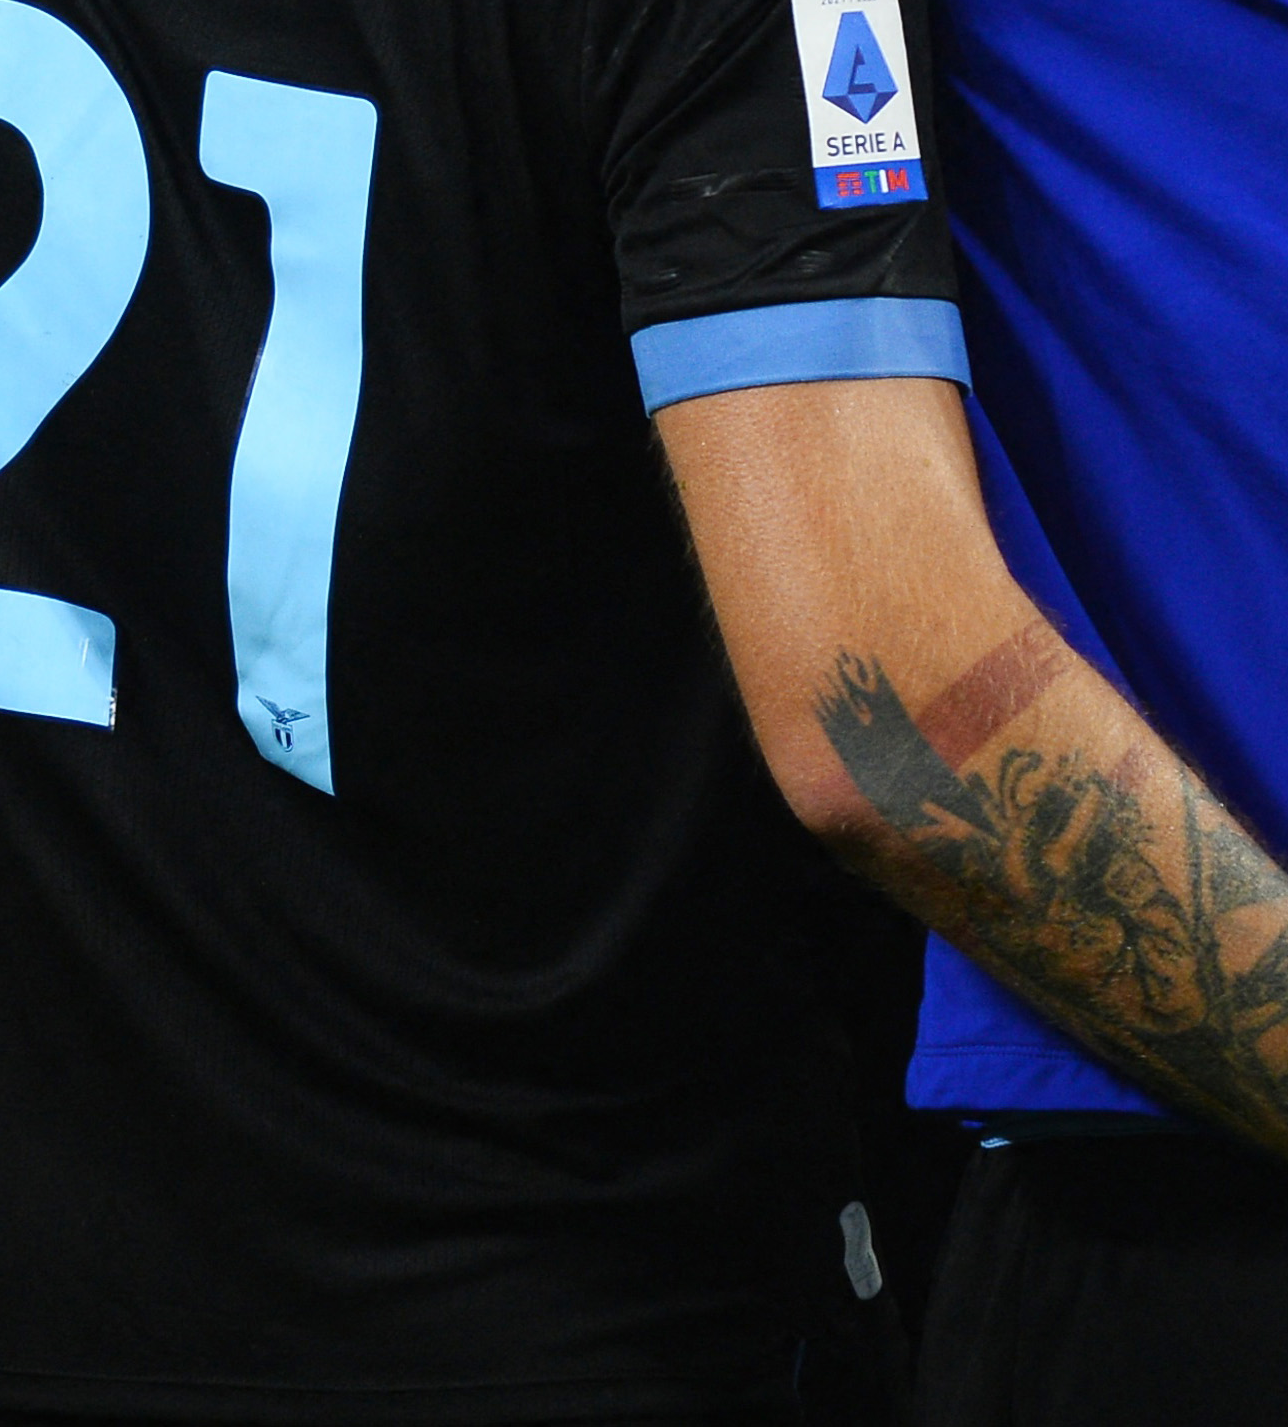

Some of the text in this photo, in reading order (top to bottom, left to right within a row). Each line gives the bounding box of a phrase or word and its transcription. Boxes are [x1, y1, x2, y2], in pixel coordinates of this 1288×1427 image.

[826, 131, 907, 158] SERIE A
[863, 168, 910, 194] TIM
